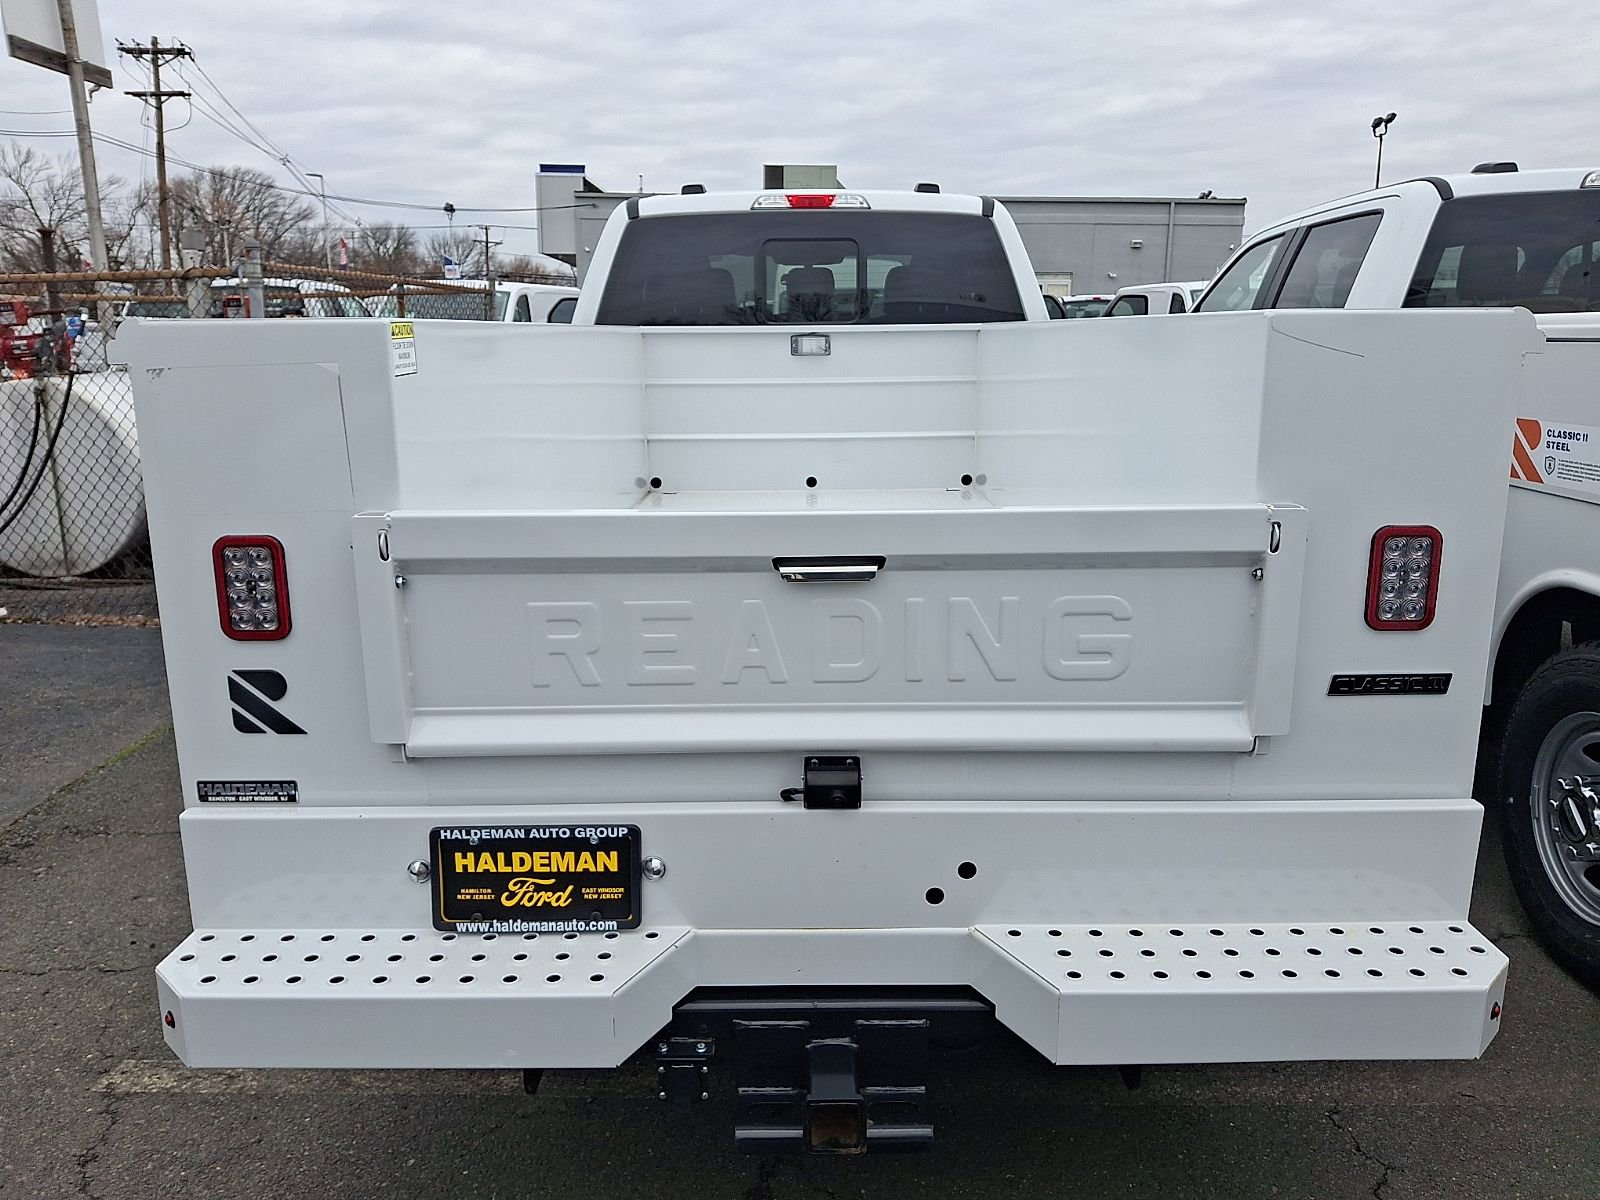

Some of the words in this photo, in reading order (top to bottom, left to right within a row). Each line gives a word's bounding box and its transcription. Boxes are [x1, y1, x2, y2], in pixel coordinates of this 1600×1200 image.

[1546, 428, 1582, 442] CLASSIC
[1582, 433, 1589, 443] II
[1545, 440, 1571, 452] STEEL
[526, 594, 1134, 688] READING
[1335, 677, 1424, 691] CLASSIC
[198, 783, 296, 796] HALDEMAN
[440, 828, 525, 839] HALDEMAN
[529, 828, 571, 838] AUTO
[574, 827, 629, 838] GROUP
[454, 851, 618, 873] HALDEMAN
[500, 877, 575, 907] Ford
[455, 919, 618, 932] www.haldemanauto.com
